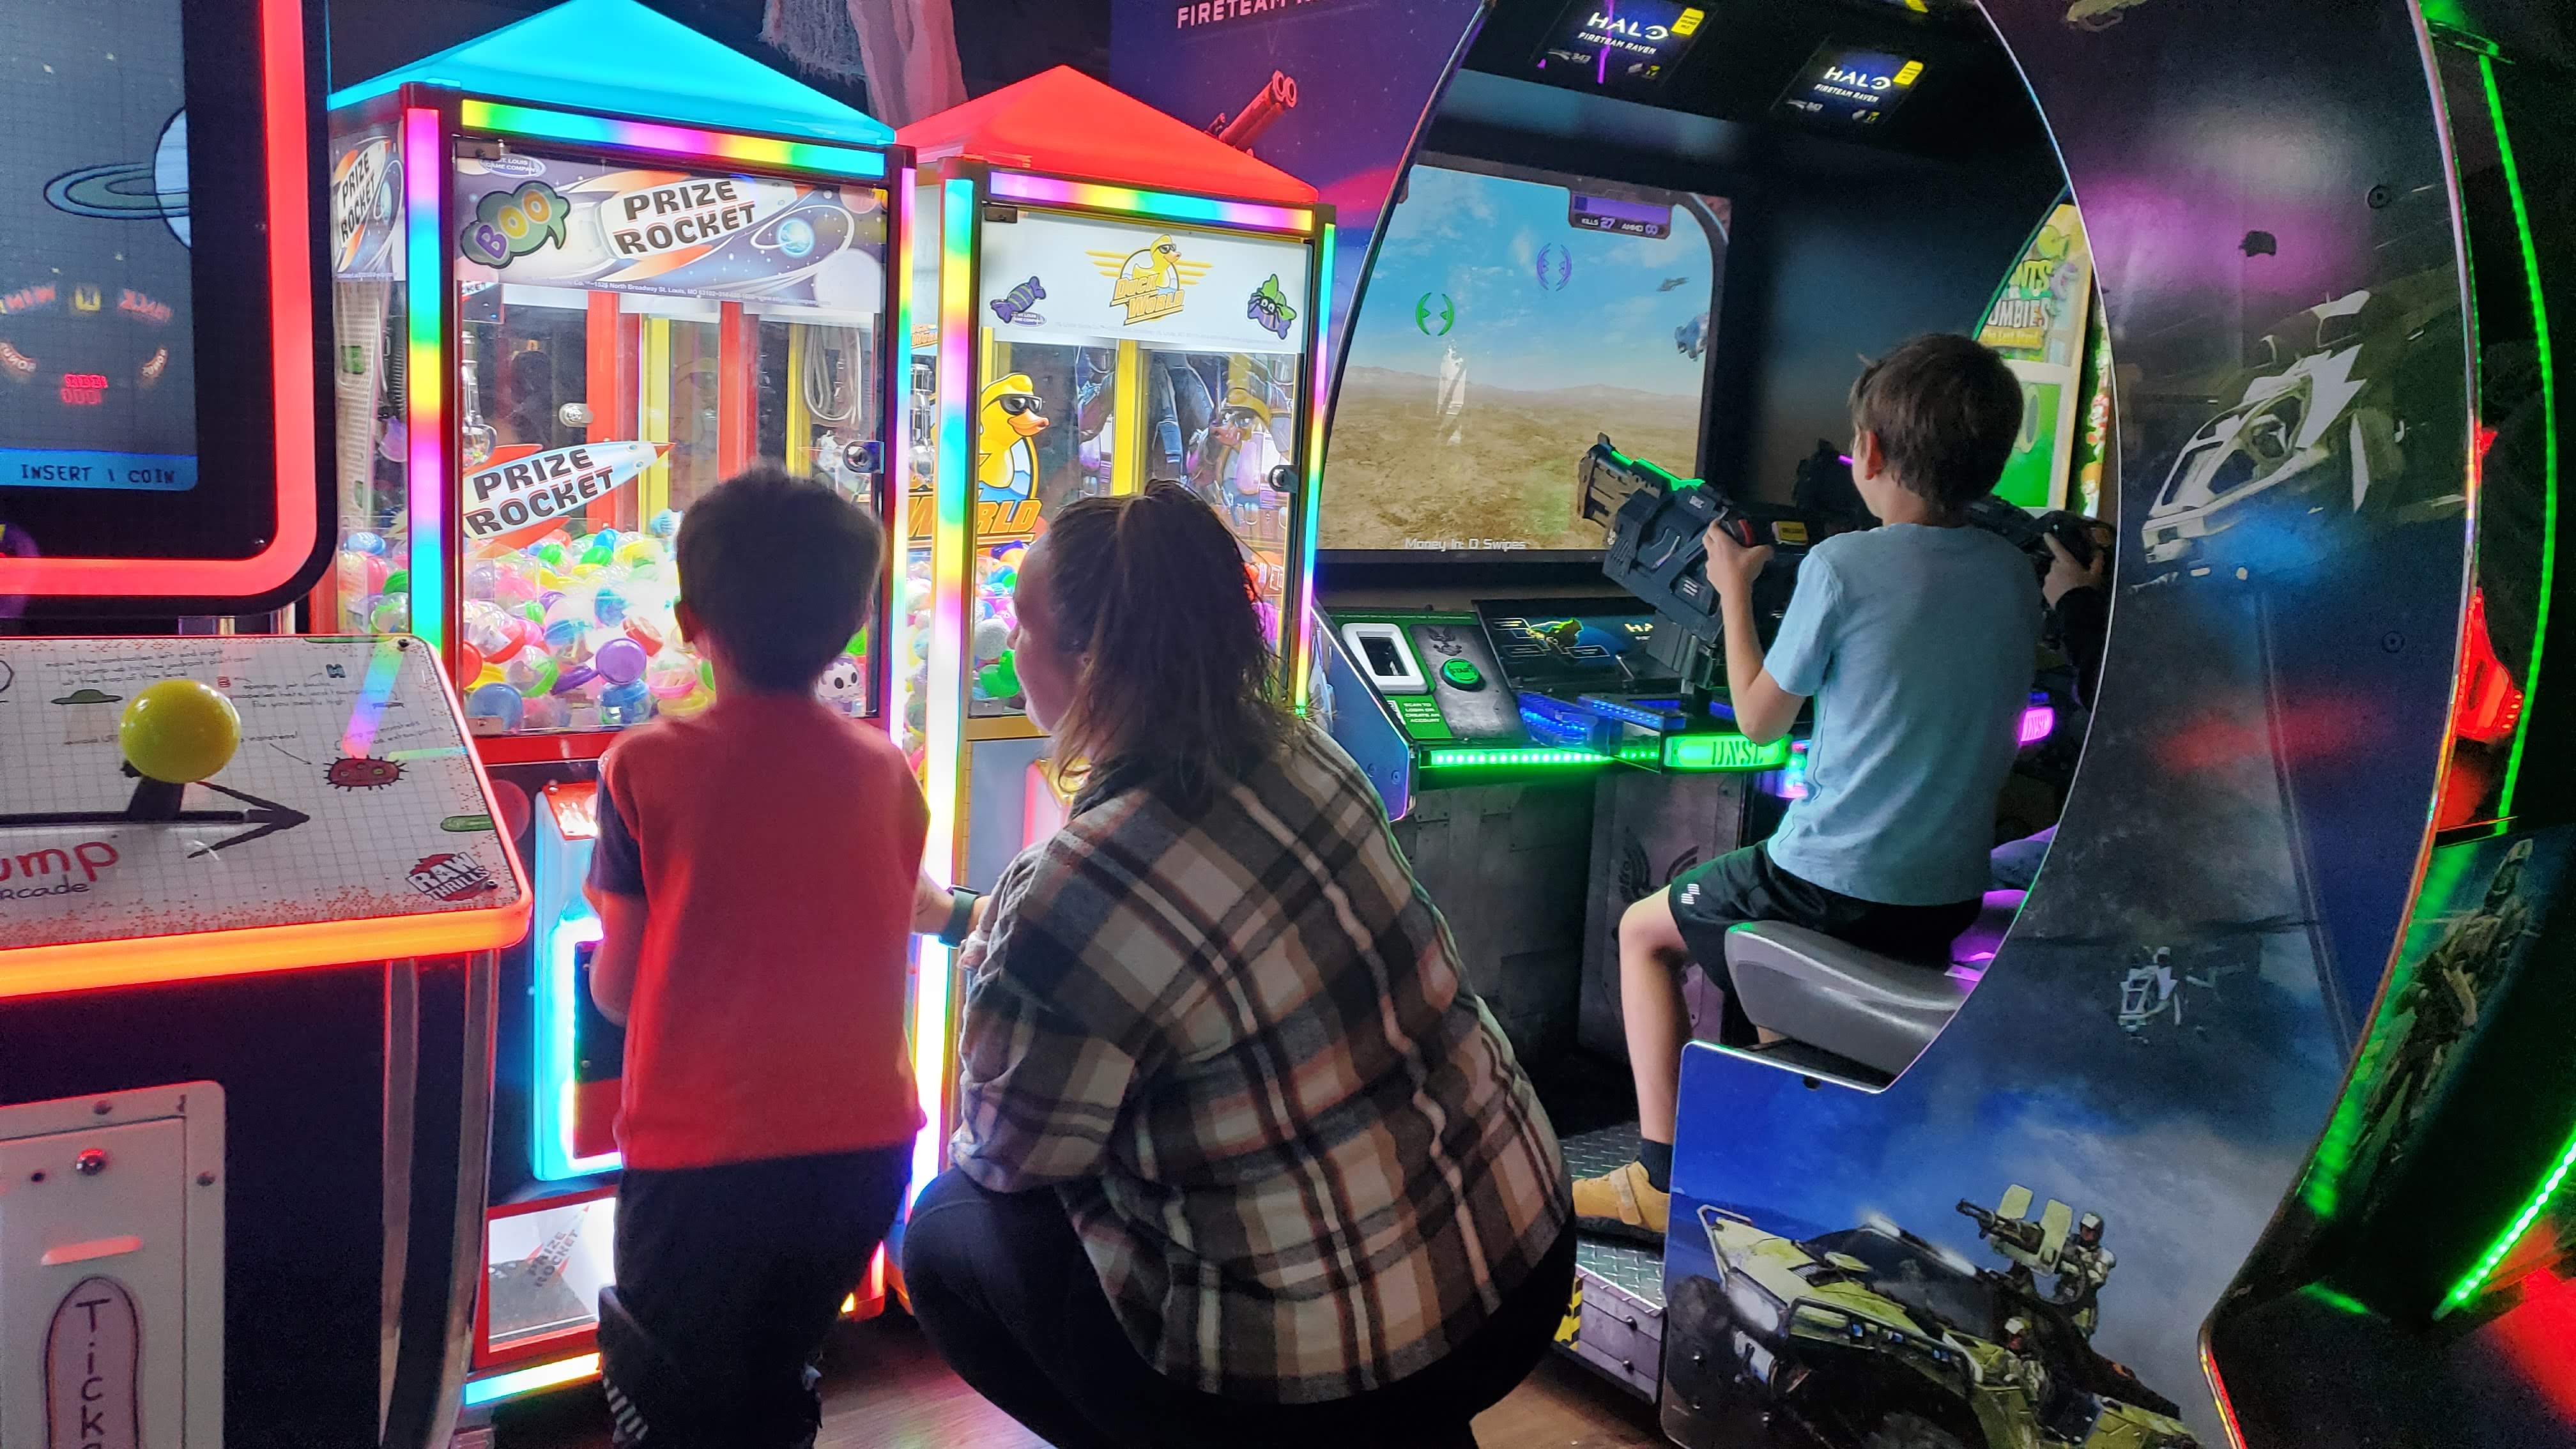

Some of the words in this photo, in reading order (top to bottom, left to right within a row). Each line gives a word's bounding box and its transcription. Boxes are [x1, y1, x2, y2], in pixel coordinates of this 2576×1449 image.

[1577, 32, 1625, 49] FIRETEAM
[1624, 40, 1657, 55] RAVEN
[1586, 12, 1669, 40] HALO
[1823, 66, 1891, 89] HALO
[342, 151, 370, 209] PRIZE
[341, 172, 375, 243] ROCKET
[623, 180, 738, 223] PRIZE
[475, 190, 552, 260] BOO
[613, 203, 756, 255] ROCKET
[1600, 217, 1615, 229] 27
[21, 464, 93, 481] INSERT
[128, 469, 175, 484] COIN
[473, 448, 594, 503] PRIZE
[464, 466, 613, 535] ROCKET
[1406, 538, 1446, 552] Money
[1482, 538, 1527, 552] Swipes
[0, 841, 119, 882] ump
[405, 852, 480, 893] RAW
[424, 866, 491, 900] THRILLS
[75, 1298, 111, 1449] Tick
